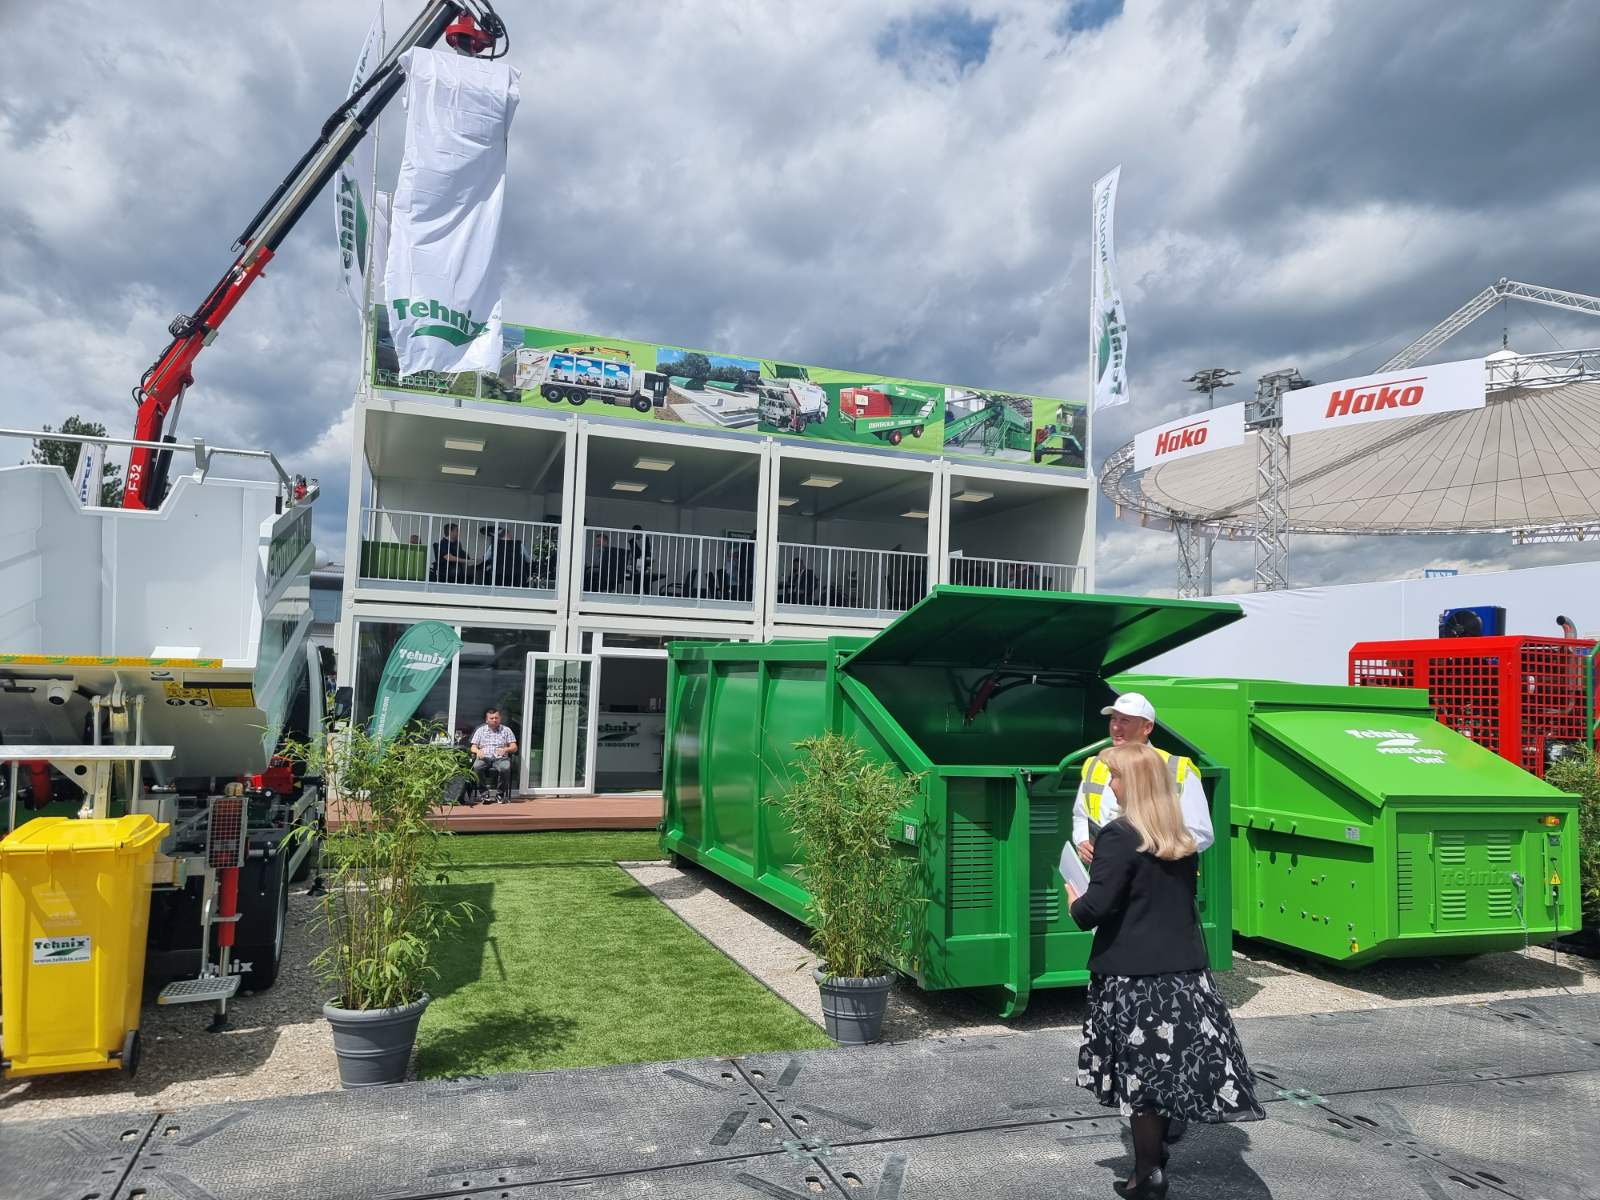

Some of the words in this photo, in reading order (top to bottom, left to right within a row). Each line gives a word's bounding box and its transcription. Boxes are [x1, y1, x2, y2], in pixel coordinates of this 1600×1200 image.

[335, 173, 357, 286] ehnix
[392, 298, 490, 337] Tehnix
[1325, 385, 1424, 419] Hako
[1155, 425, 1208, 456] Hako
[128, 464, 142, 491] F32
[399, 648, 447, 665] Tehnix
[598, 720, 638, 733] ehnix
[34, 938, 86, 950] Tehnix
